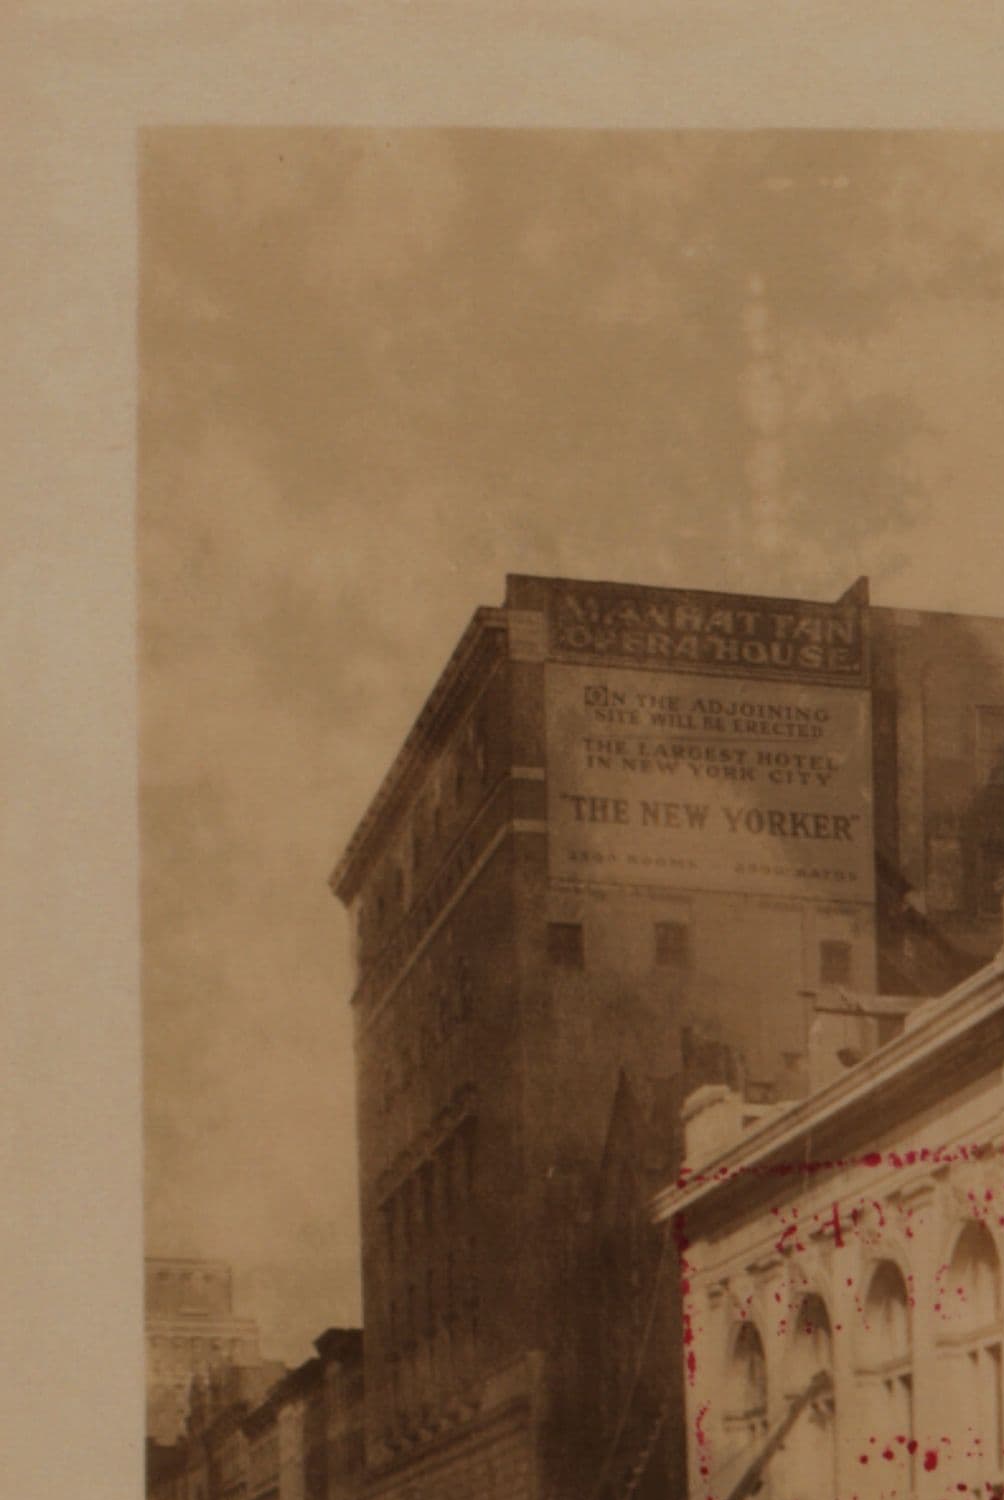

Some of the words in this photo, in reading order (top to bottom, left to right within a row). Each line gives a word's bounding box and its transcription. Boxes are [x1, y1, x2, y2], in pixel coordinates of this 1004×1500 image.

[563, 595, 854, 644] MANHATTAN
[565, 625, 700, 660] OPERA
[712, 638, 859, 672] HOUSE
[584, 685, 627, 707] ON
[637, 694, 681, 713] THE
[690, 698, 830, 723] ADJOINING
[594, 709, 640, 726] SITE
[650, 713, 697, 731] WILL
[703, 716, 726, 733] BE
[732, 719, 824, 739] ERECTED
[583, 737, 627, 756] THE
[638, 741, 748, 765] LARGEST
[756, 750, 839, 772] HOTEL
[586, 755, 613, 770] IN
[622, 757, 680, 776] NEW
[688, 761, 756, 784] YORK
[767, 768, 834, 787] CITY
[640, 800, 710, 831] NEW
